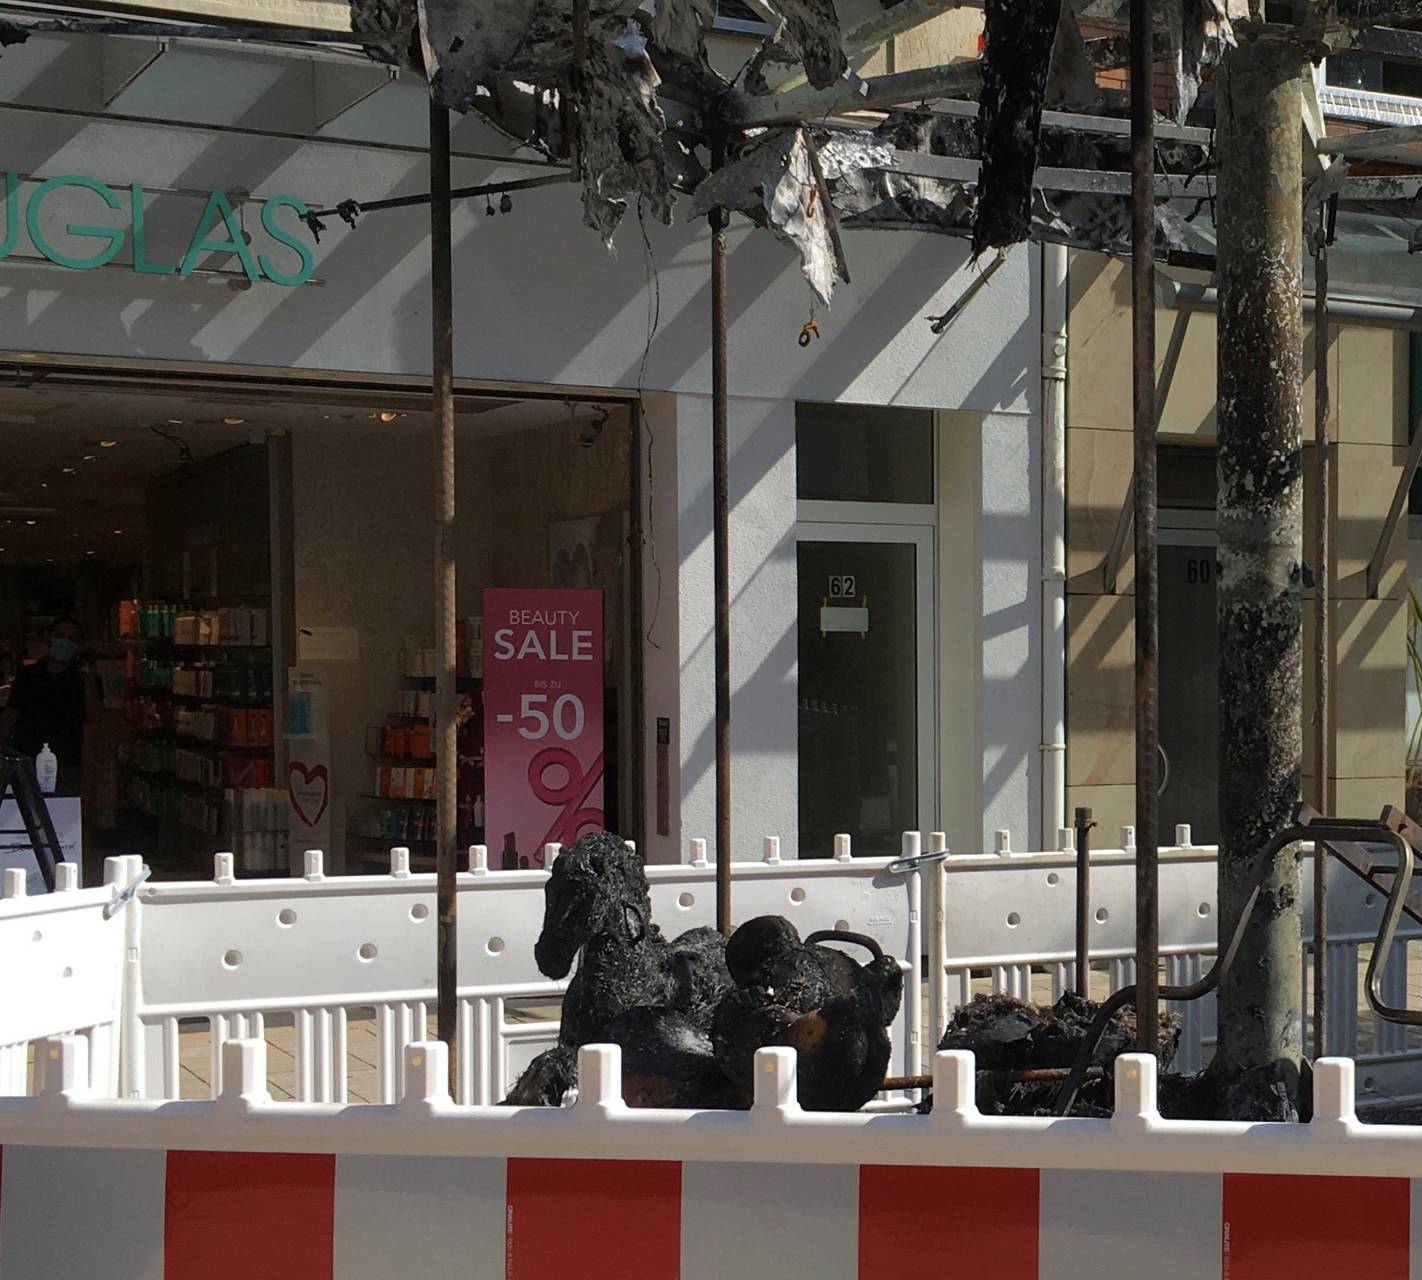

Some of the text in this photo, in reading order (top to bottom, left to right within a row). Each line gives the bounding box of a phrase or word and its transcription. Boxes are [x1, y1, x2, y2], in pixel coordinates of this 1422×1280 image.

[1187, 560, 1210, 584] 60
[830, 577, 855, 596] 62
[509, 610, 580, 625] BEAUTY
[494, 629, 593, 661] SALE
[534, 680, 561, 688] BIS ZU
[497, 694, 585, 740] -50
